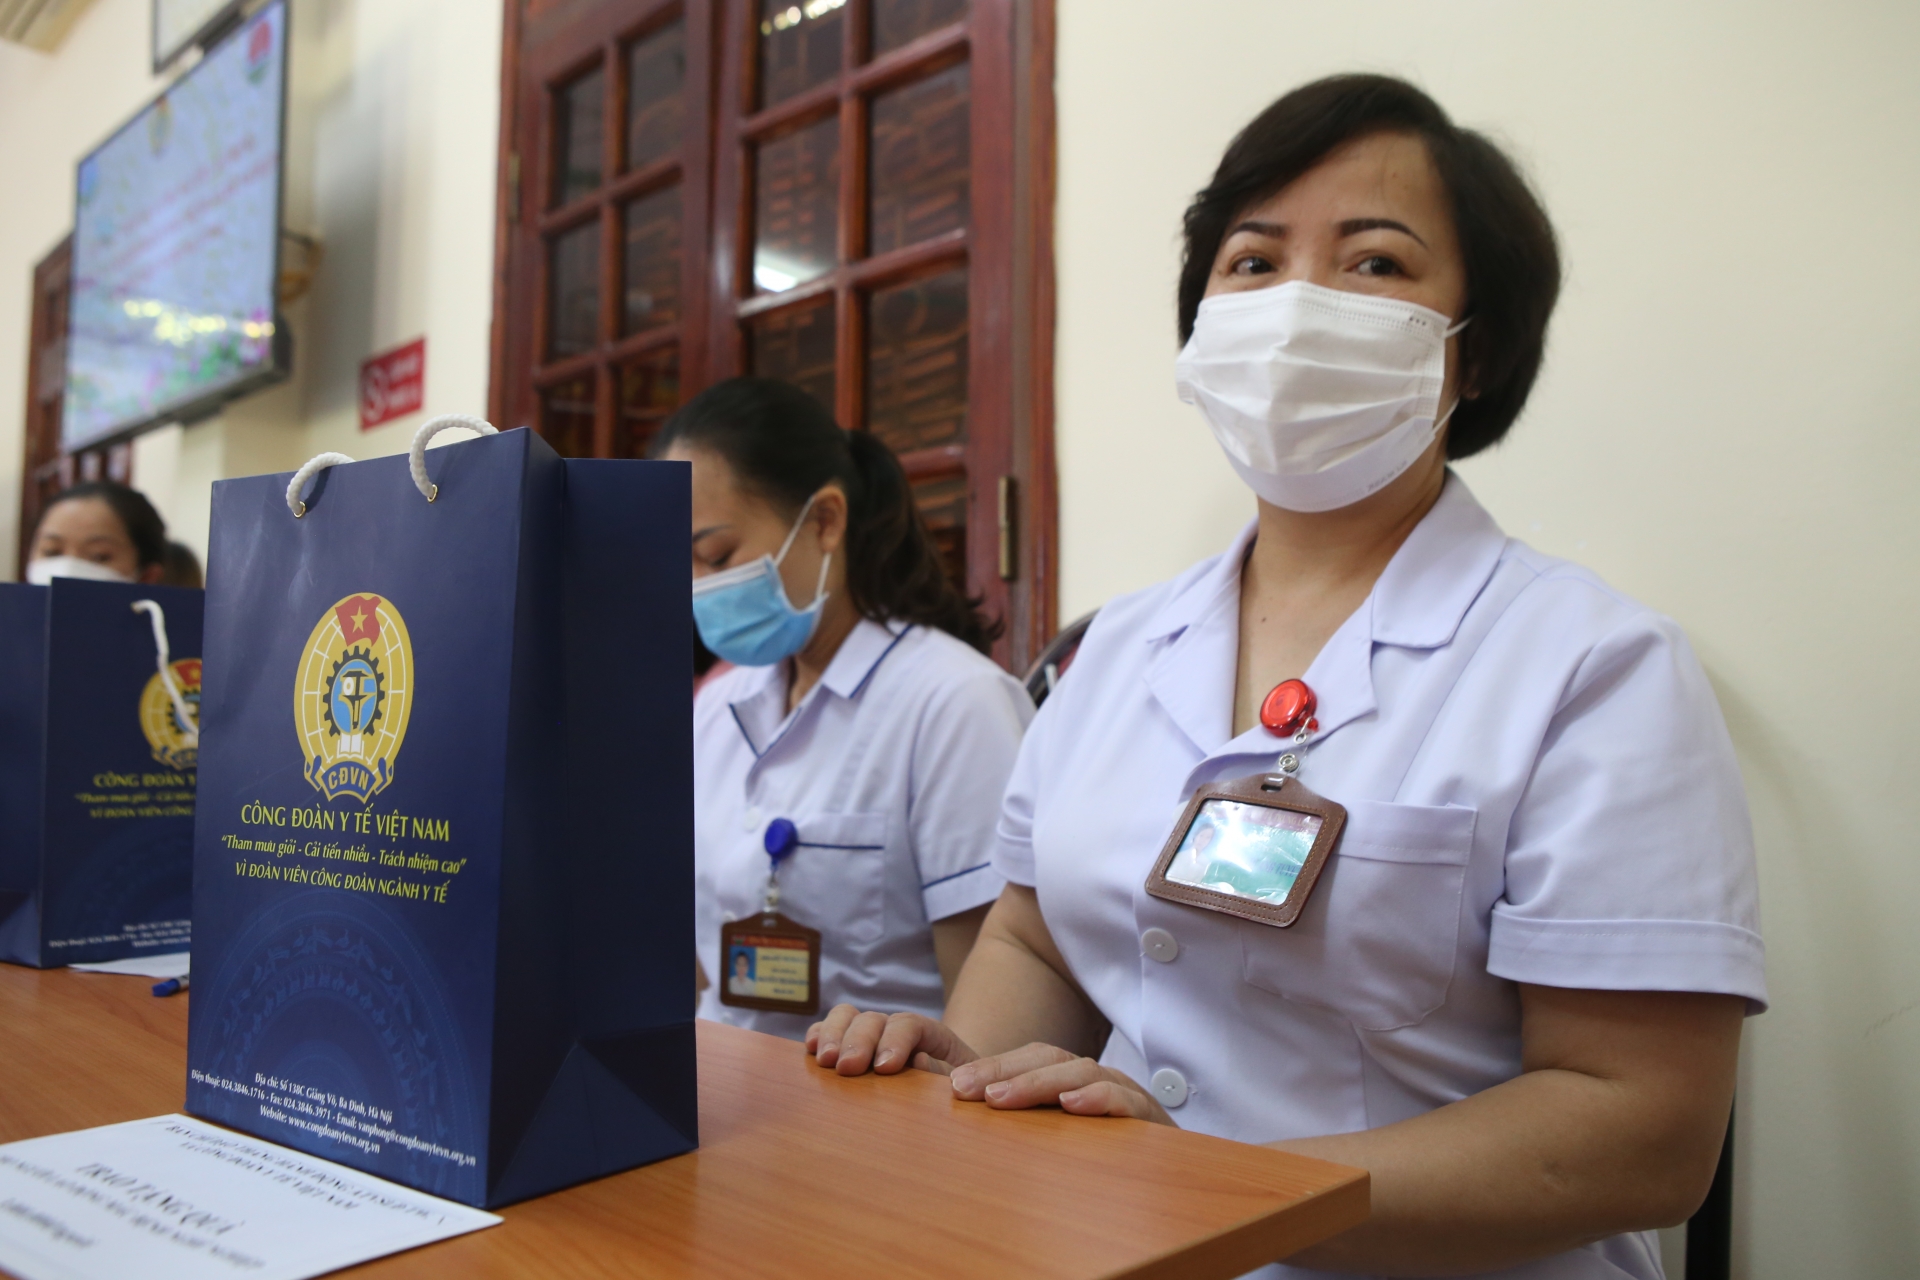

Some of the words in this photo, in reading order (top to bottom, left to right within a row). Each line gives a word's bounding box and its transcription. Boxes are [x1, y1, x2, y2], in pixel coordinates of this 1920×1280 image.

[328, 766, 369, 791] CĐVN
[241, 799, 286, 827] CÔNG
[291, 802, 335, 831] ĐOÀN
[340, 811, 350, 832] Y
[354, 802, 374, 834] TẾ
[376, 808, 408, 842] VIỆT
[412, 816, 449, 842] NAM
[254, 840, 276, 853] mưu
[276, 838, 297, 858] giỏi
[304, 841, 321, 857] Cải
[322, 841, 341, 860] tiến
[379, 849, 405, 868] Trách
[407, 851, 439, 875] nhiệm
[236, 858, 247, 877] VÌ
[248, 861, 281, 881] ĐOÀN
[283, 864, 309, 884] VIÊN
[310, 867, 342, 889] CÔNG
[344, 872, 376, 893] ĐOÀN
[378, 876, 420, 899] NGÀNH
[422, 884, 431, 901] Y
[434, 879, 451, 904] TẾ
[221, 1078, 265, 1100] 024.3846.1716
[283, 1096, 331, 1120] 024.3846.3971
[288, 1082, 305, 1096] 138C
[338, 1096, 348, 1109] Ba
[368, 1105, 379, 1119] Hà
